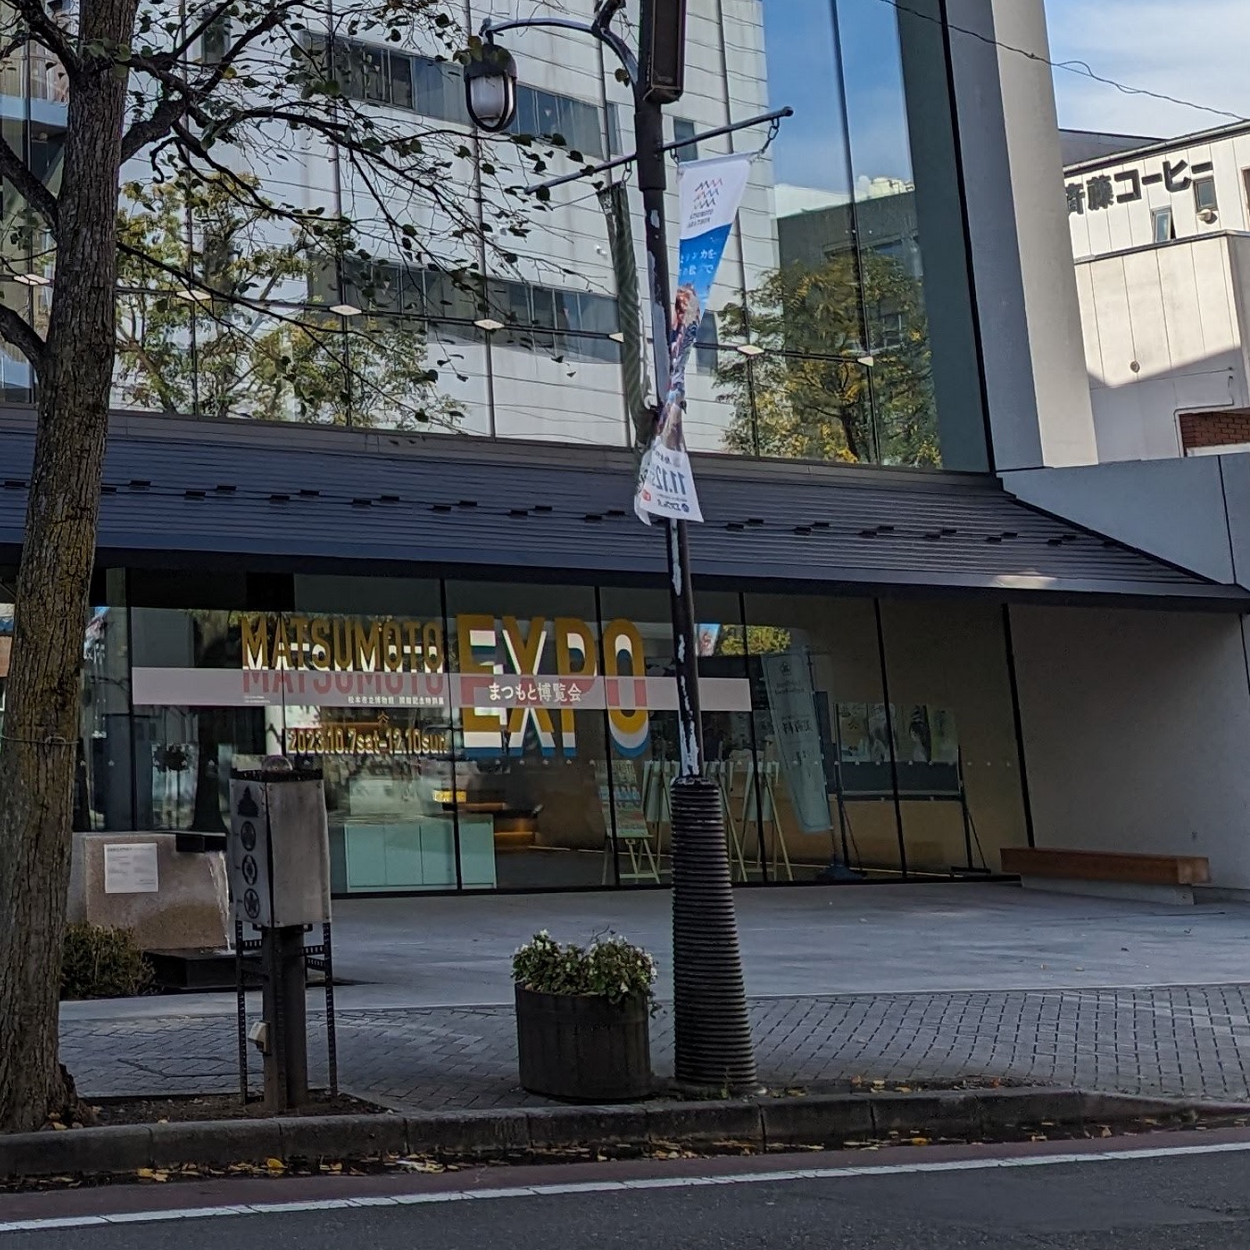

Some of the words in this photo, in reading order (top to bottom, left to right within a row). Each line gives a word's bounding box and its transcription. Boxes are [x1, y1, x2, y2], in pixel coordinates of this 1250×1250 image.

[240, 615, 445, 695] MATSUMOTO
[457, 614, 650, 760] EXPO
[488, 682, 582, 702] まつもと博覧会
